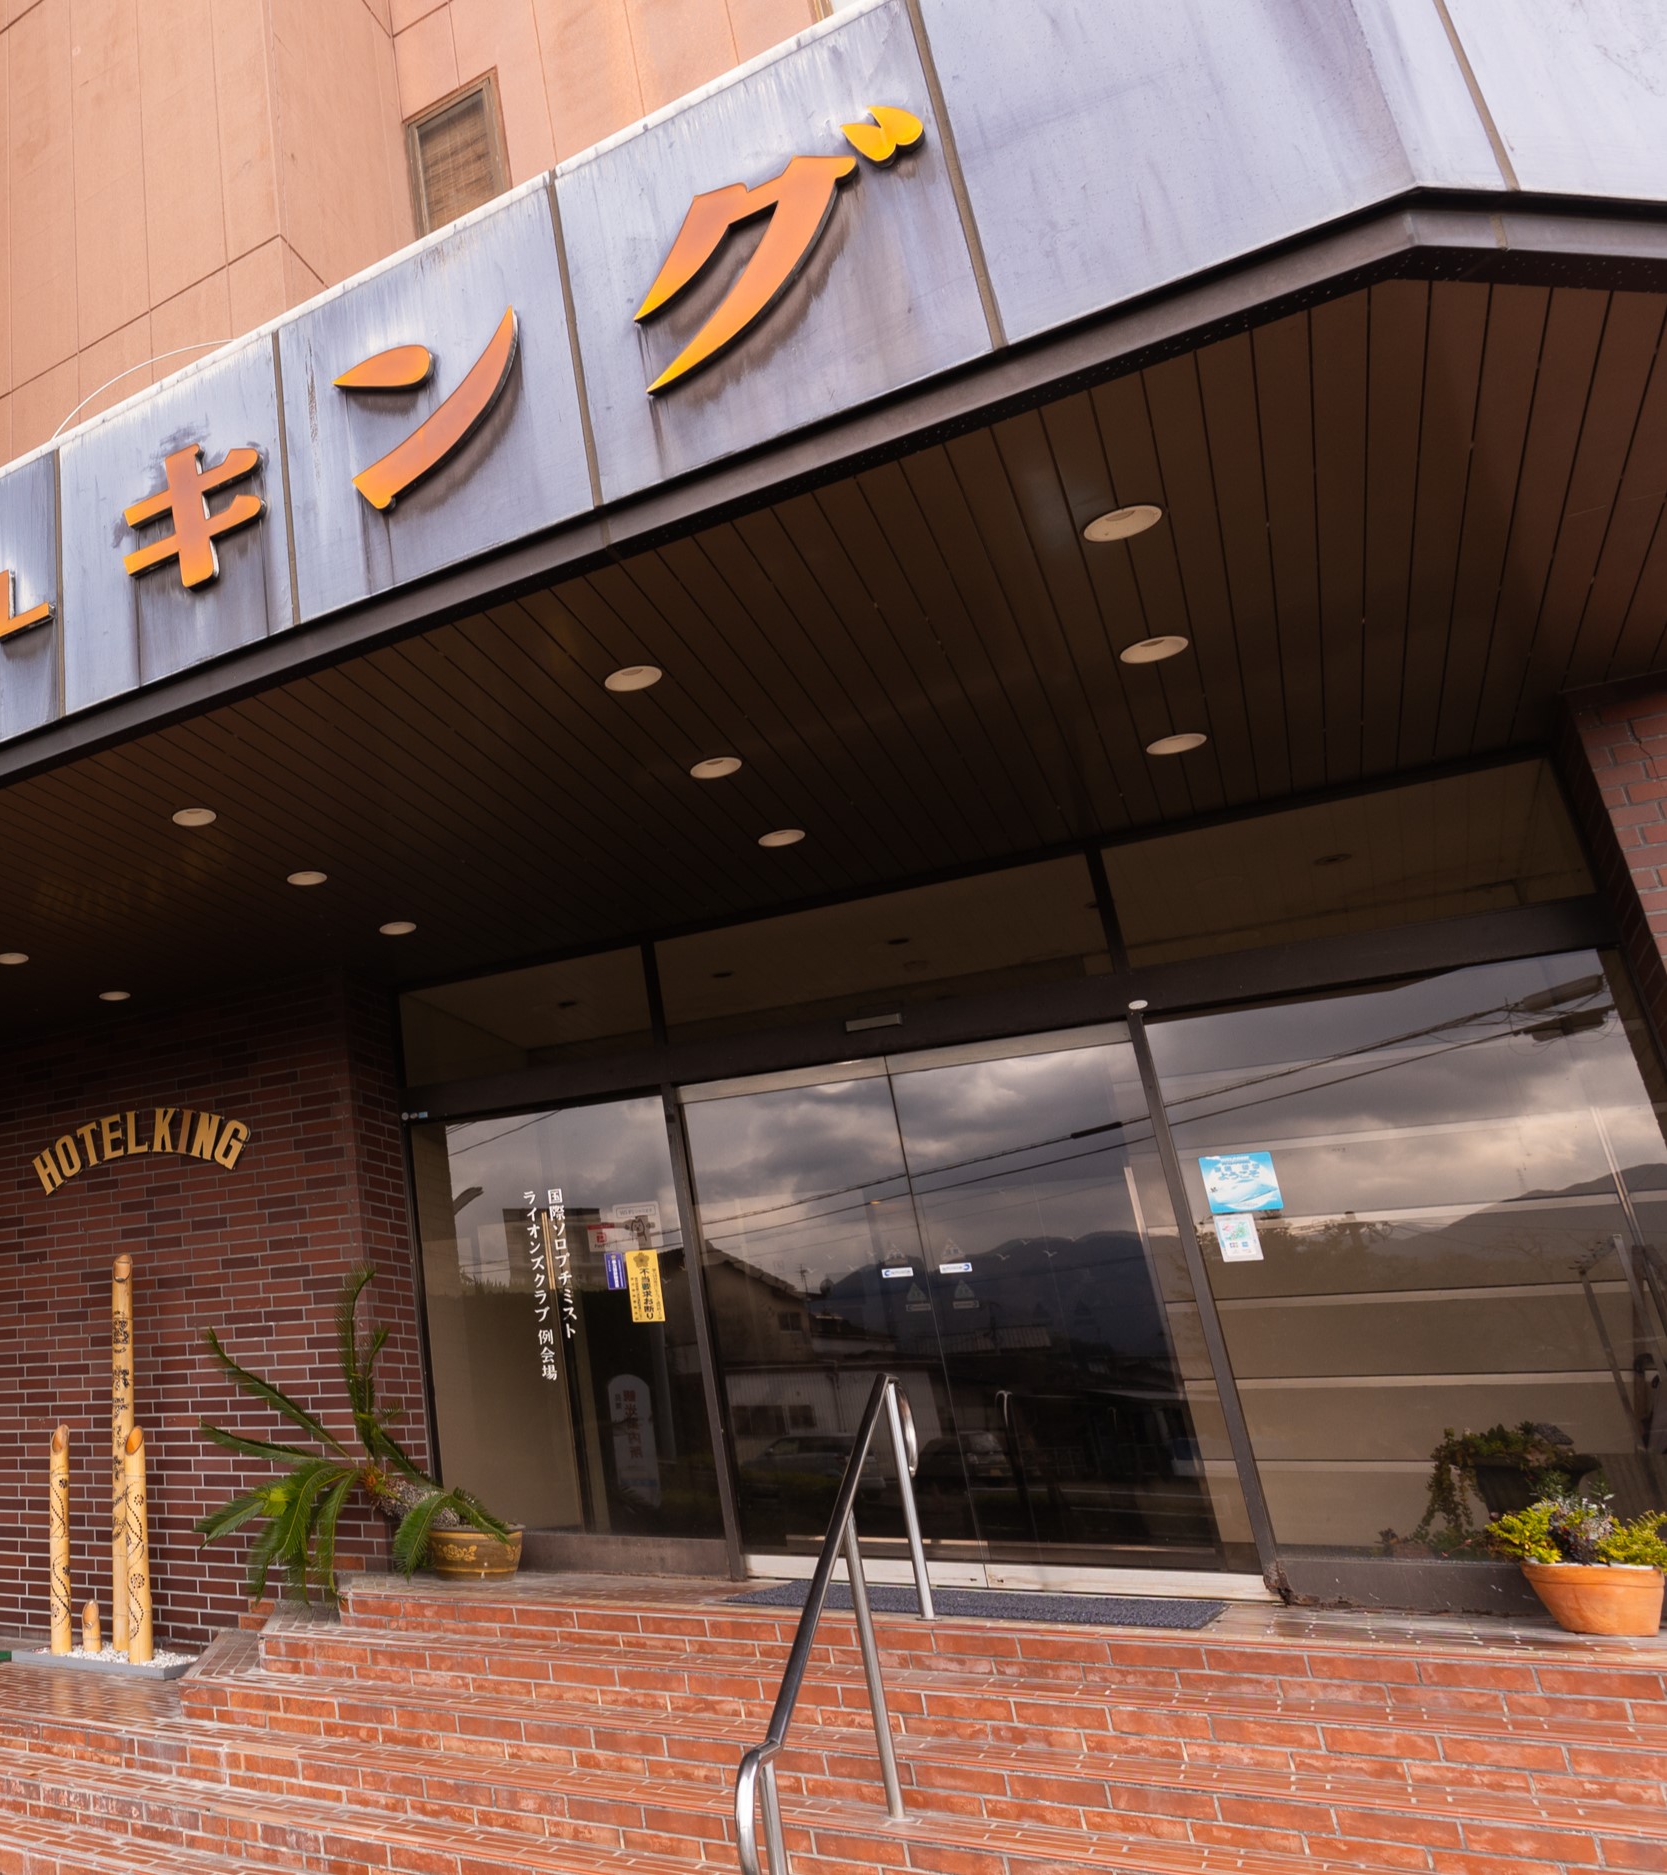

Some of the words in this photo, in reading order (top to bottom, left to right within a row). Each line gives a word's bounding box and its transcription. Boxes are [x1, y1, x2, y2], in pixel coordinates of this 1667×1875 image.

[123, 106, 925, 589] キング
[547, 1188, 578, 1340] 国際ソロプチミスト
